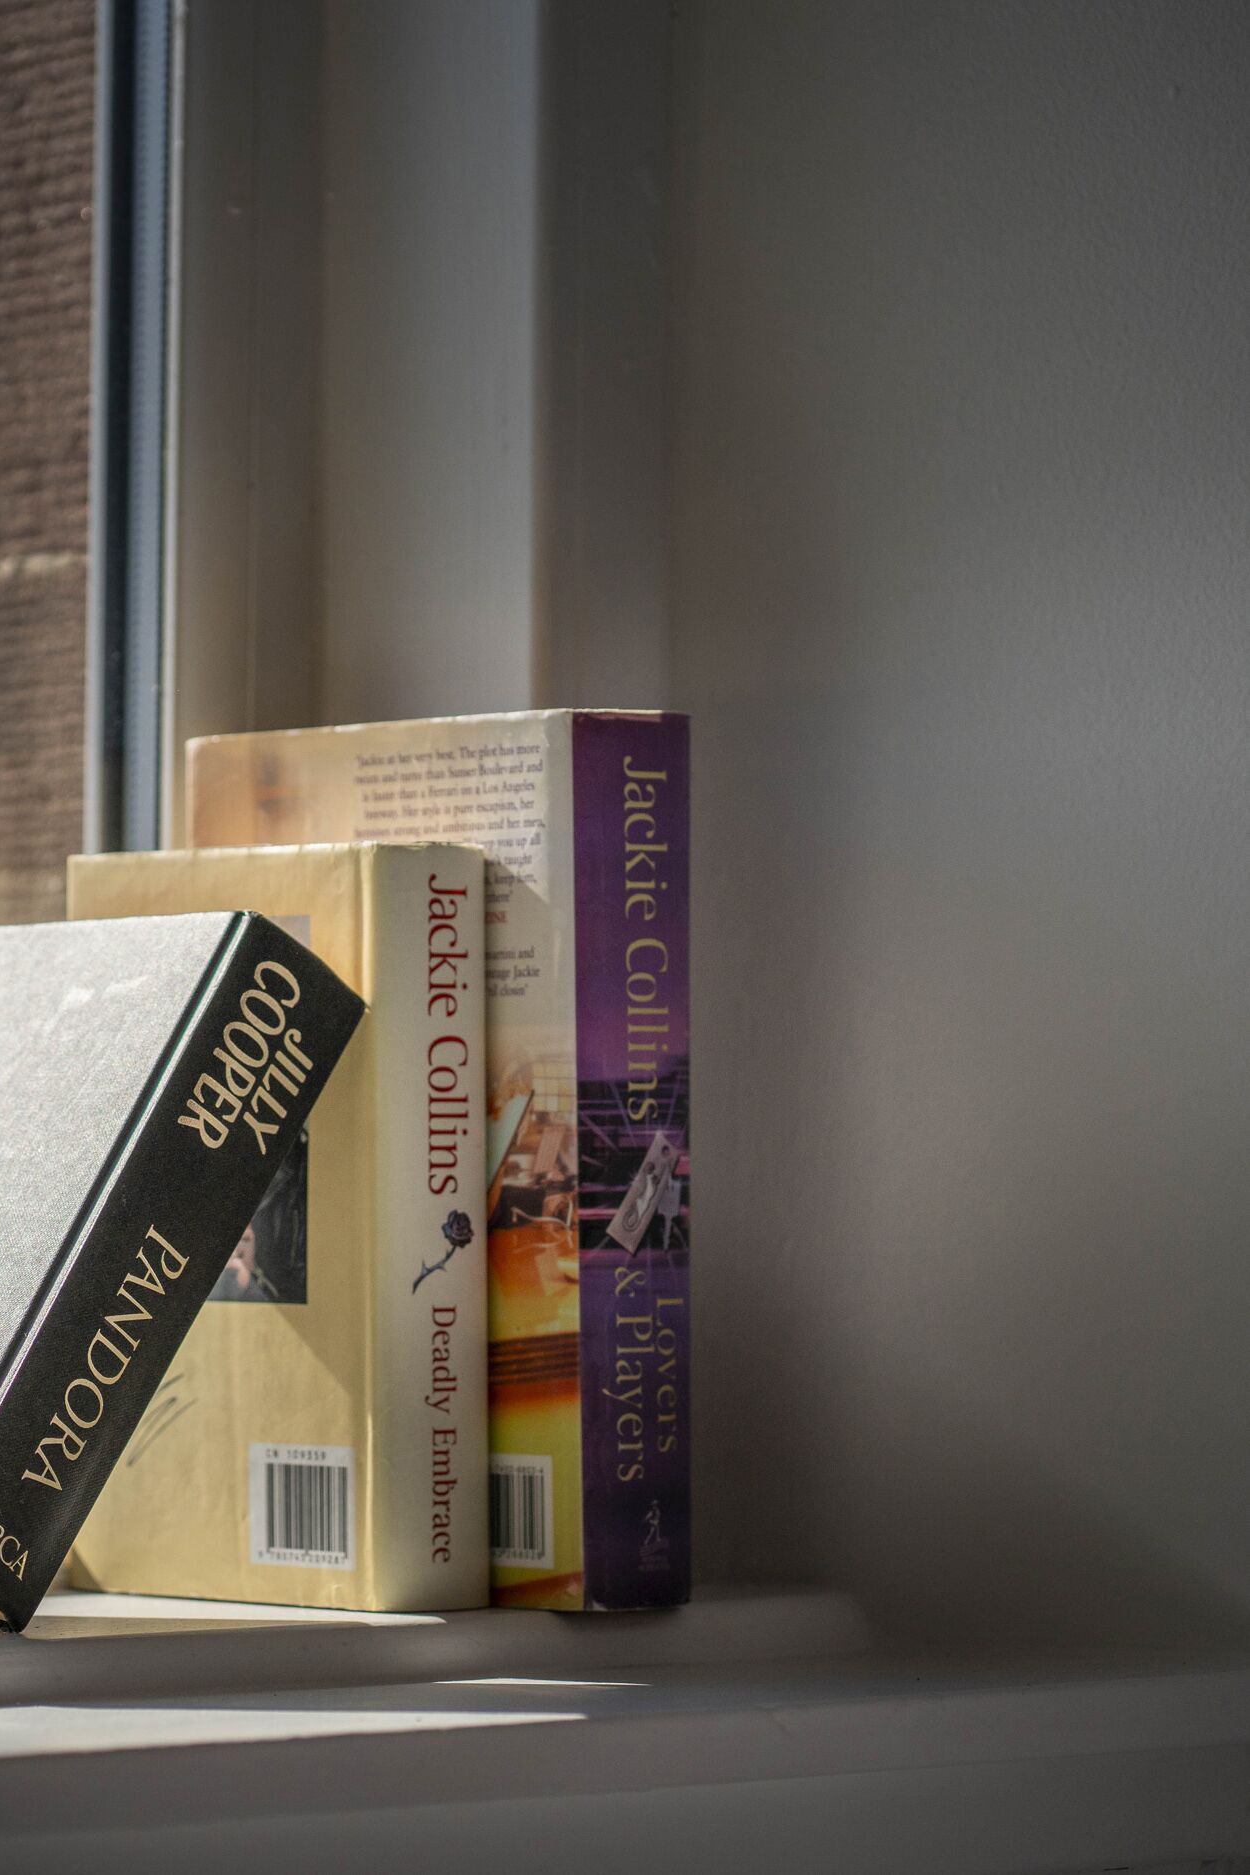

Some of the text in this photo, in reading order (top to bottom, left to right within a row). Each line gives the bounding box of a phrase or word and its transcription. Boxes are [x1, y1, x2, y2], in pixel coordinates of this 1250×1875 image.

[482, 781, 499, 794] Los
[501, 778, 536, 795] Angeles
[488, 817, 505, 830] and
[506, 815, 522, 829] her
[516, 744, 541, 755] more
[526, 759, 543, 773] and
[512, 964, 541, 980] Jackie
[622, 755, 670, 1121] Jackie Collins
[177, 960, 301, 1149] COOPER
[242, 1028, 314, 1155] JILLY
[427, 873, 469, 1196] Jackie Collins
[21, 1224, 190, 1491] PANDORA
[424, 1304, 458, 1564] Deadly Embrace
[602, 1266, 655, 1483] & Players
[655, 1297, 684, 1454] Lovers
